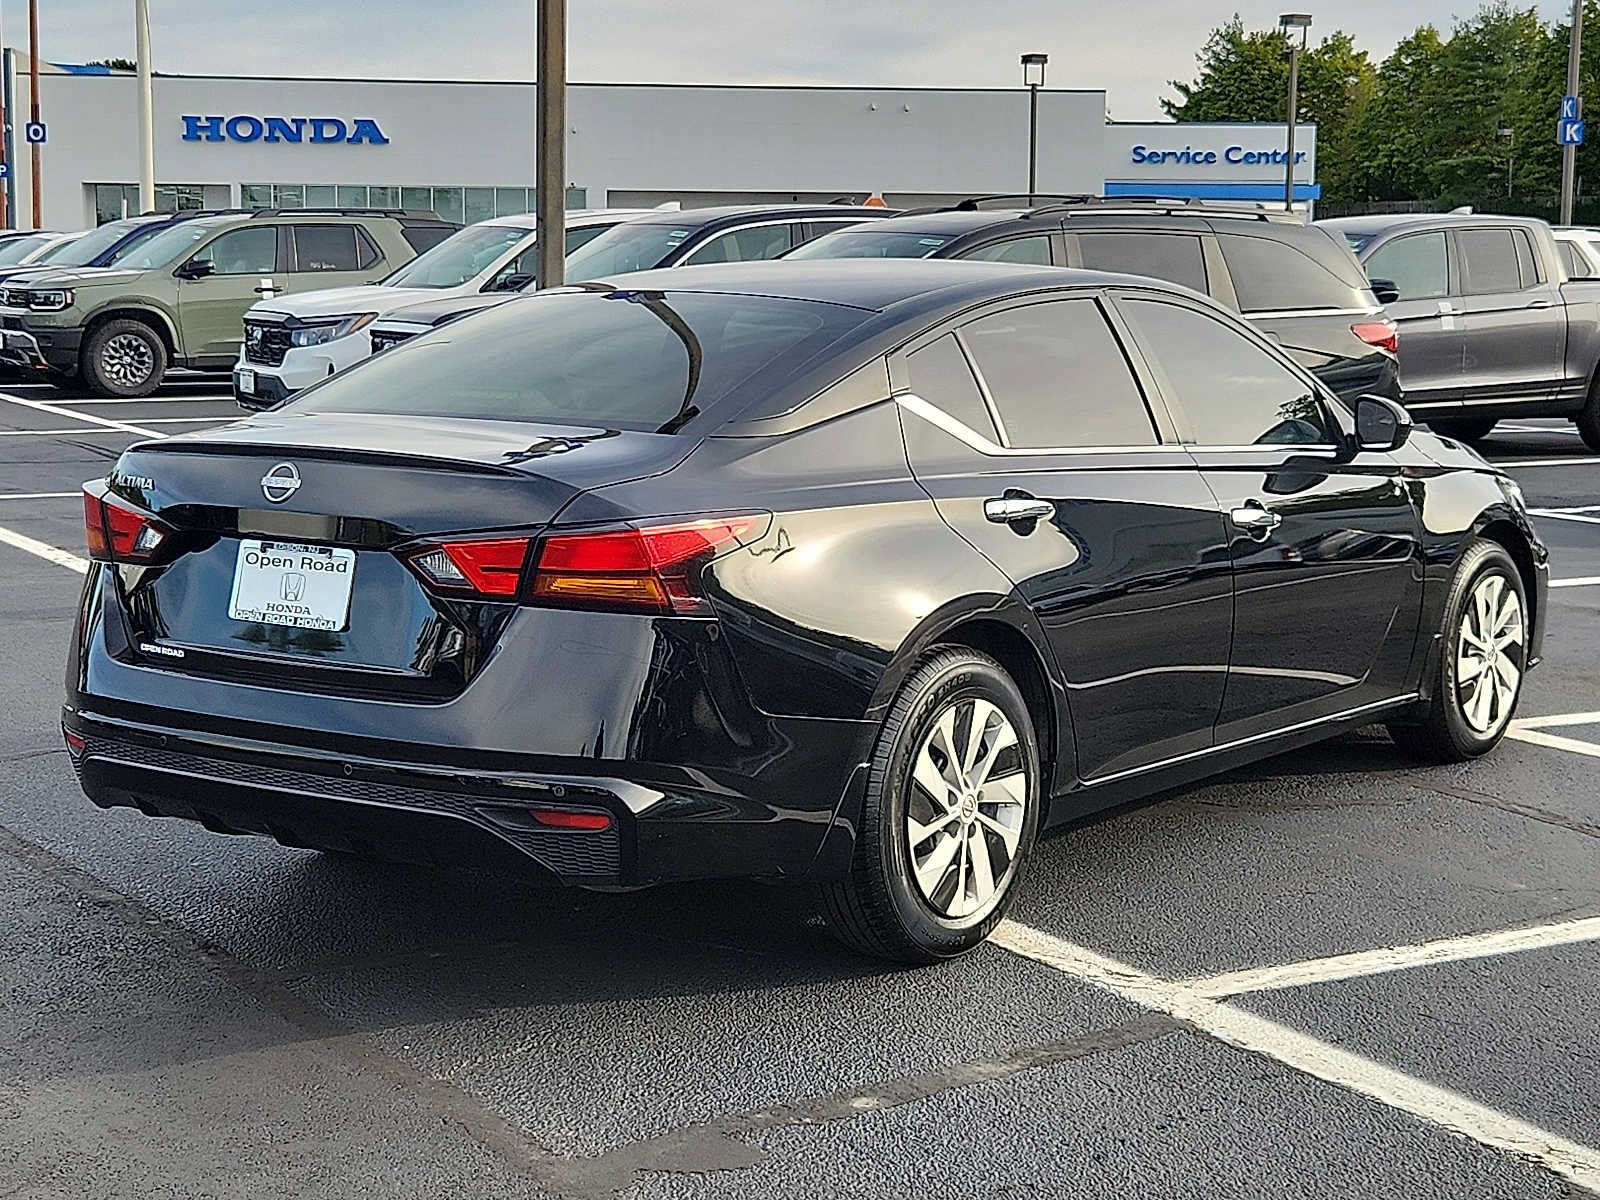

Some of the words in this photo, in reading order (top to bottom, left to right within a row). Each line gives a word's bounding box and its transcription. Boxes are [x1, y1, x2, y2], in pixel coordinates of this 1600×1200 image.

[1563, 100, 1573, 118] K
[181, 115, 390, 145] HONDA
[1566, 123, 1580, 142] K
[1132, 145, 1217, 165] Service
[245, 552, 293, 569] Open
[300, 556, 348, 573] Road
[236, 609, 263, 621] OPEN
[265, 613, 295, 624] ROAD
[296, 616, 336, 630] HONDA
[266, 603, 312, 616] HONDA
